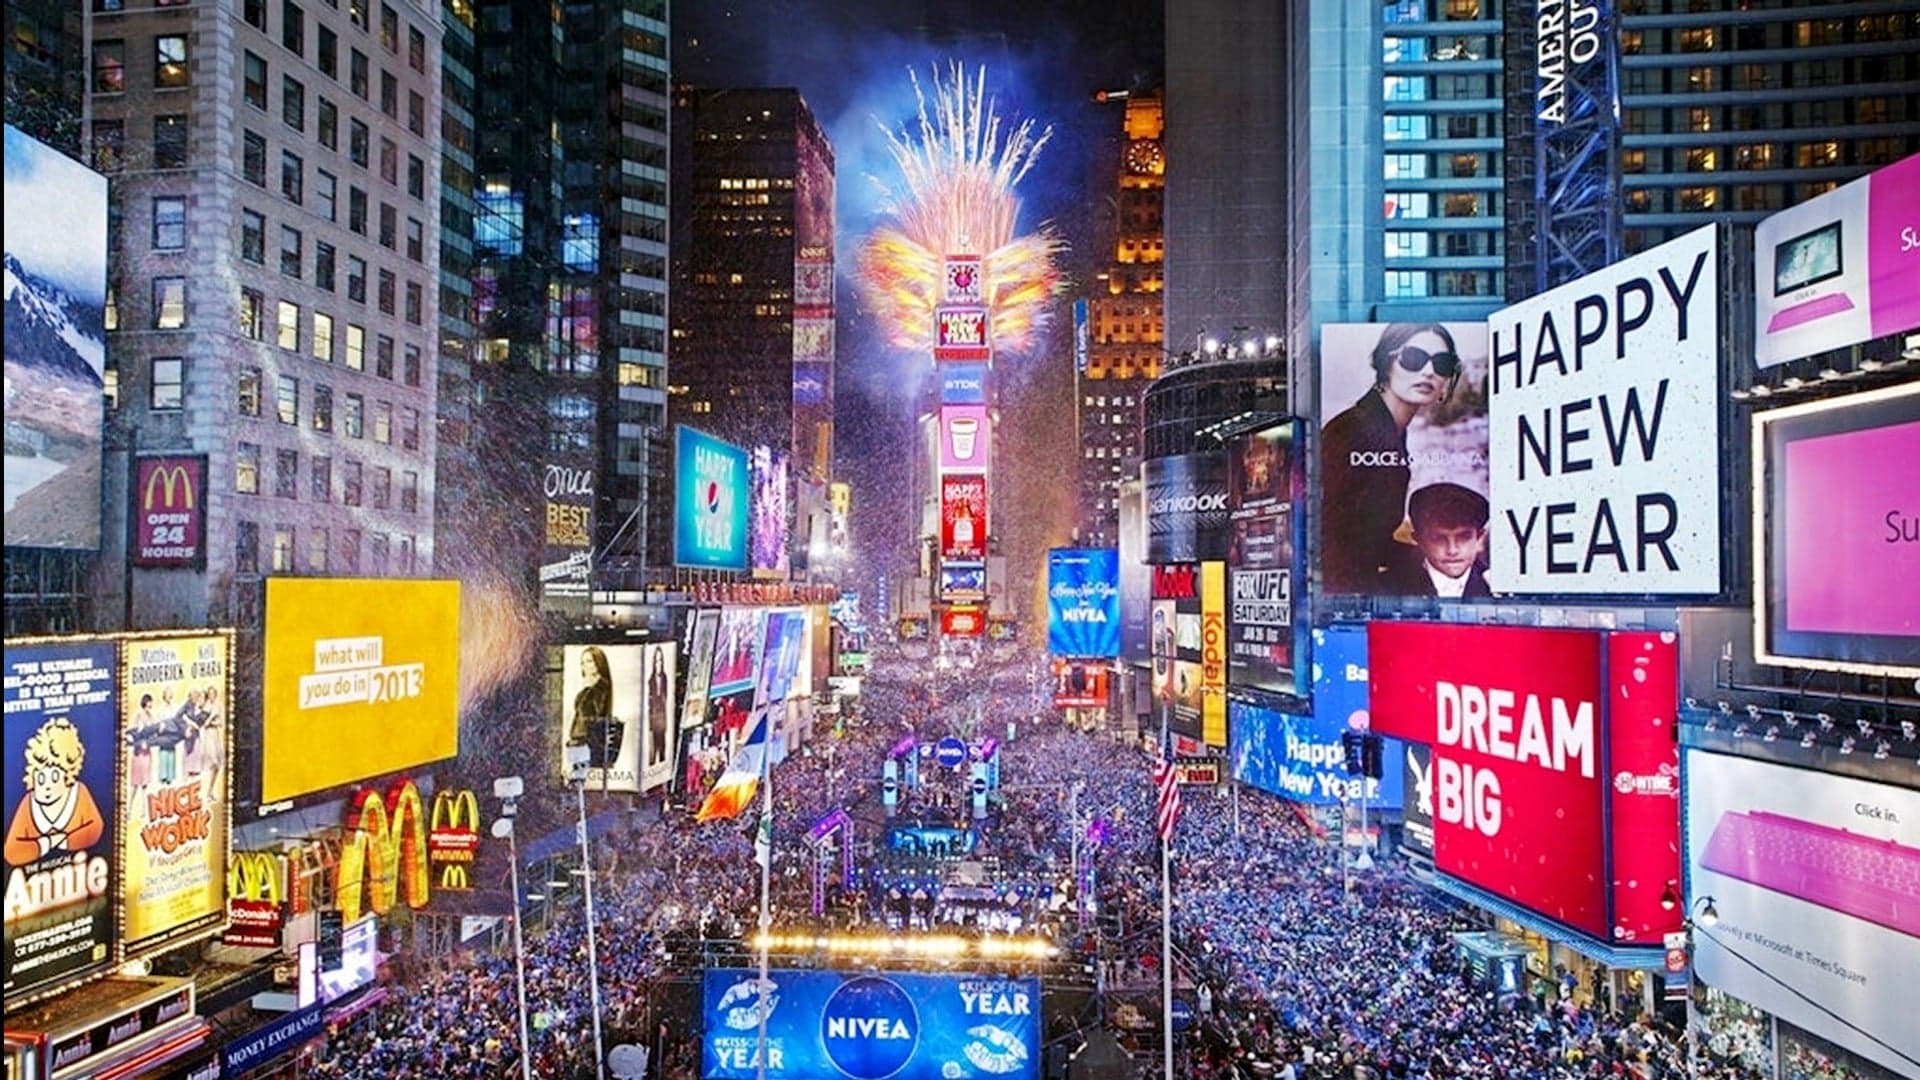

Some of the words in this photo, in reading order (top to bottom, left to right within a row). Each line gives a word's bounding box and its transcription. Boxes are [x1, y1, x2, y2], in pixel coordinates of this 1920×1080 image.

[1492, 250, 1709, 396] HAPPY
[955, 379, 979, 389] TDK
[1518, 378, 1670, 482] NEW
[147, 513, 190, 525] OPEN
[546, 503, 591, 528] BEST
[151, 526, 185, 545] 24
[1505, 491, 1680, 576] YEAR
[142, 547, 195, 558] HOURS
[1257, 572, 1288, 600] UFC
[1062, 608, 1107, 622] NIVEA
[1234, 603, 1289, 623] SATURDAY
[318, 645, 353, 665] what
[355, 642, 379, 663] will
[1204, 611, 1223, 696] Kodak
[132, 663, 184, 685] BRODERICK
[33, 684, 65, 697] BACK
[66, 681, 91, 694] AND
[304, 682, 330, 705] you
[334, 676, 352, 695] do
[354, 673, 366, 693] in
[373, 669, 424, 704] 2013
[43, 694, 74, 708] THAN
[1436, 681, 1594, 778] DREAM
[1279, 764, 1315, 796] New
[147, 781, 203, 823] NICE
[1436, 757, 1502, 838] BIG
[1855, 802, 1882, 820] Click
[140, 809, 213, 854] WORK
[4, 850, 109, 921] Annie
[960, 992, 1031, 1016] YEAR
[227, 1036, 267, 1069] MONEY
[267, 1010, 323, 1048] EXCHANGE
[827, 1017, 912, 1040] NIVEA
